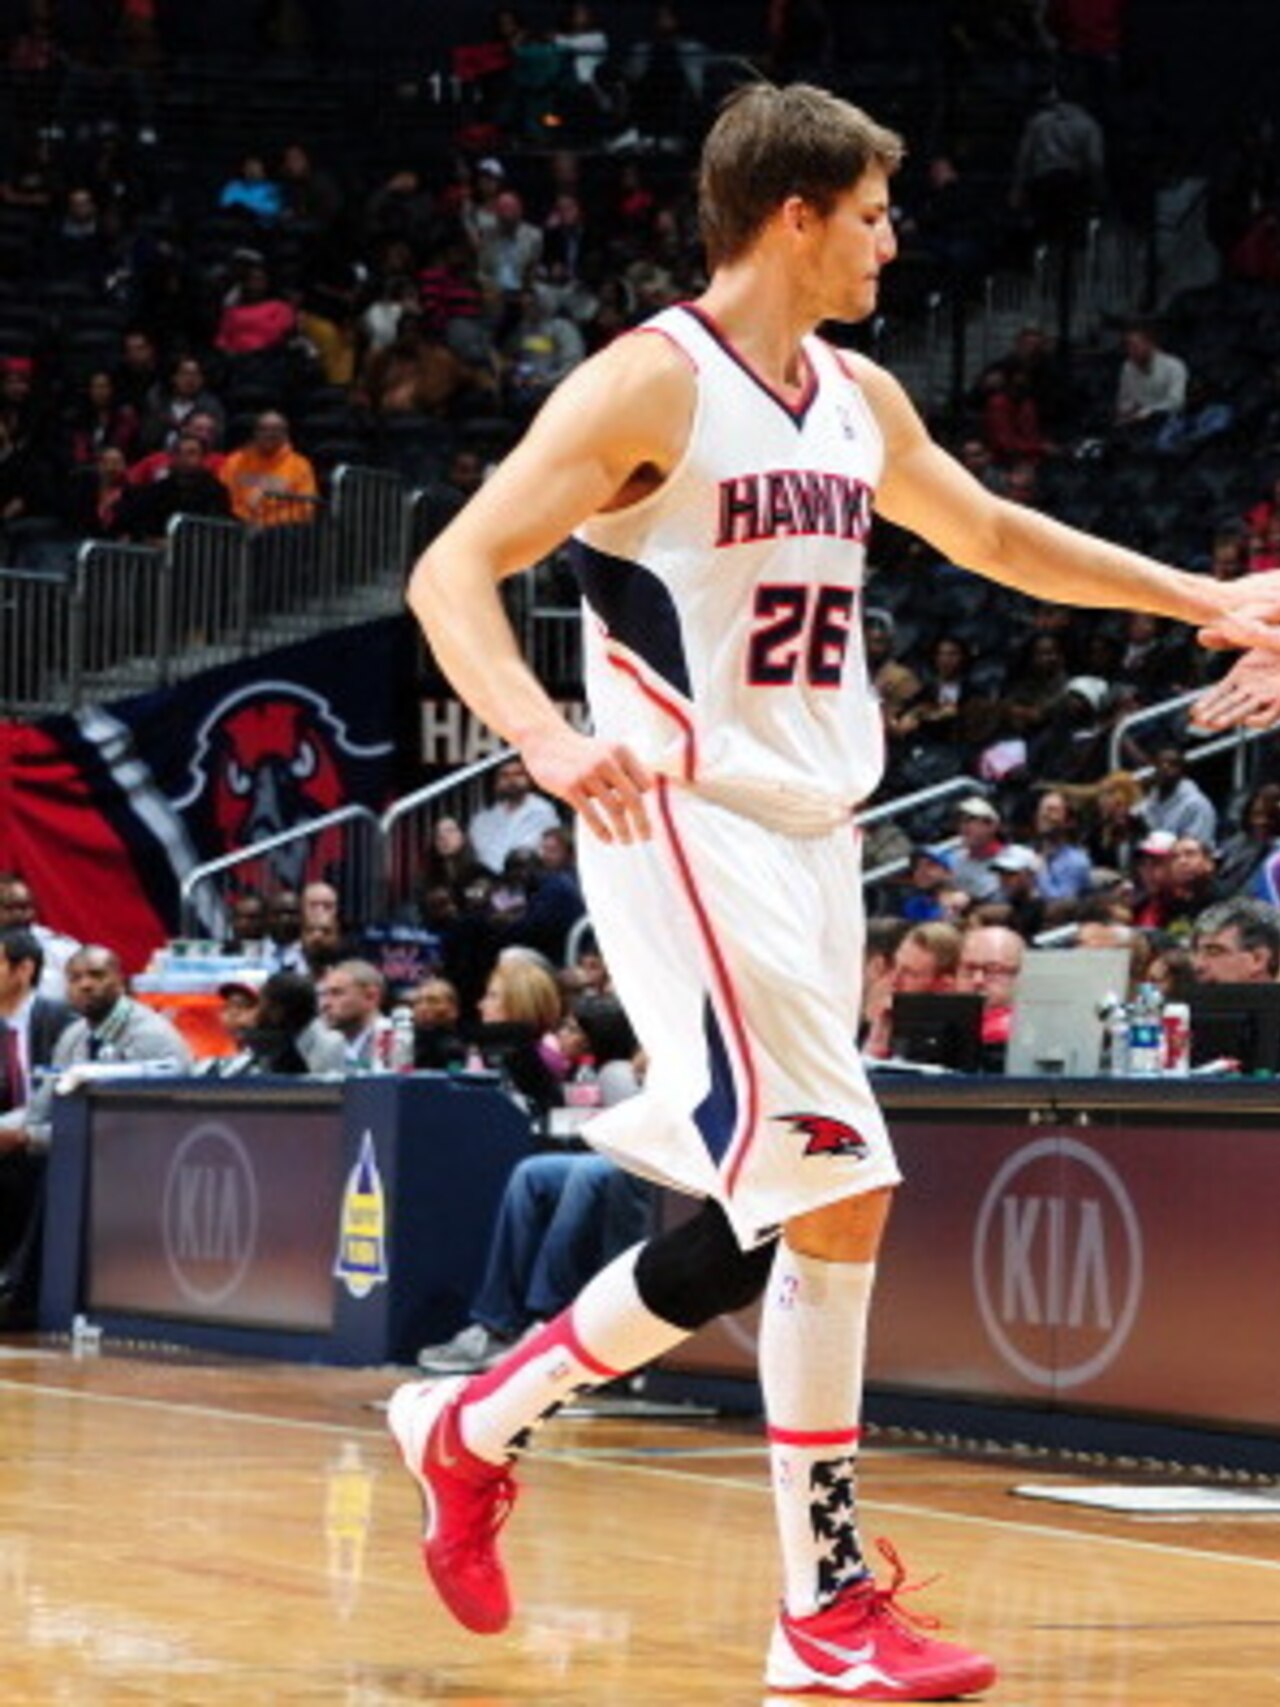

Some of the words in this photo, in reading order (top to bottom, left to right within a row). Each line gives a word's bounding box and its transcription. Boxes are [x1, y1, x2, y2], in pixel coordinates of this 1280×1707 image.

[715, 469, 876, 547] HAWK
[746, 582, 856, 689] 26
[179, 1165, 238, 1260] KIA
[1002, 1195, 1113, 1329] KIA
